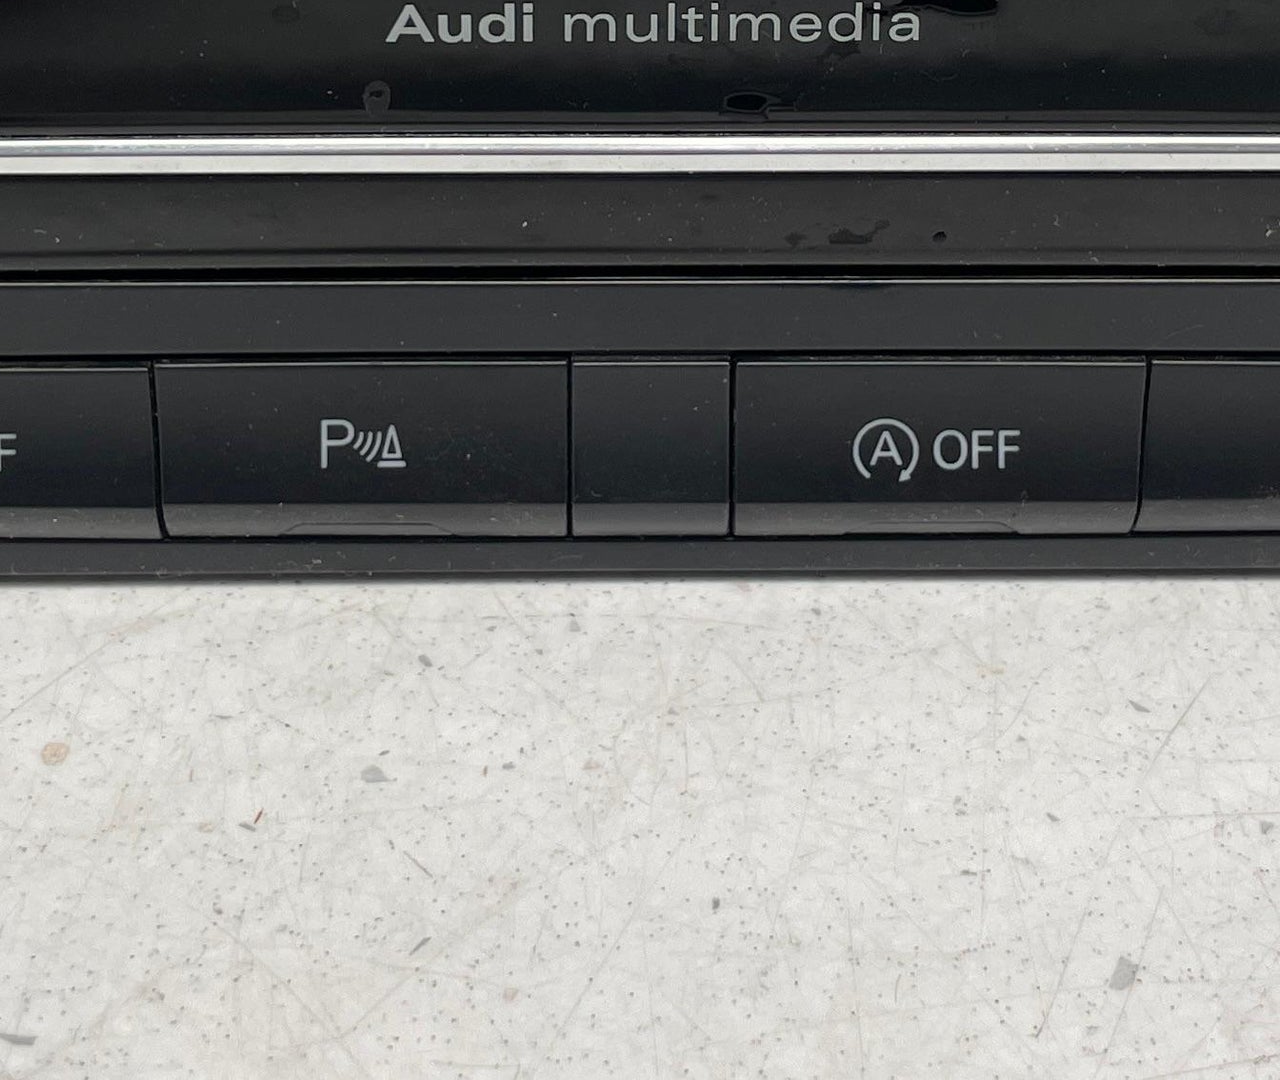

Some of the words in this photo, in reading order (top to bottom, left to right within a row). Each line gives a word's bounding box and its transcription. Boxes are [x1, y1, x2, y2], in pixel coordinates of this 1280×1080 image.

[385, 2, 534, 44] Audi
[564, 1, 921, 43] multimedia
[320, 419, 355, 468] P
[933, 429, 1021, 470] OFF
